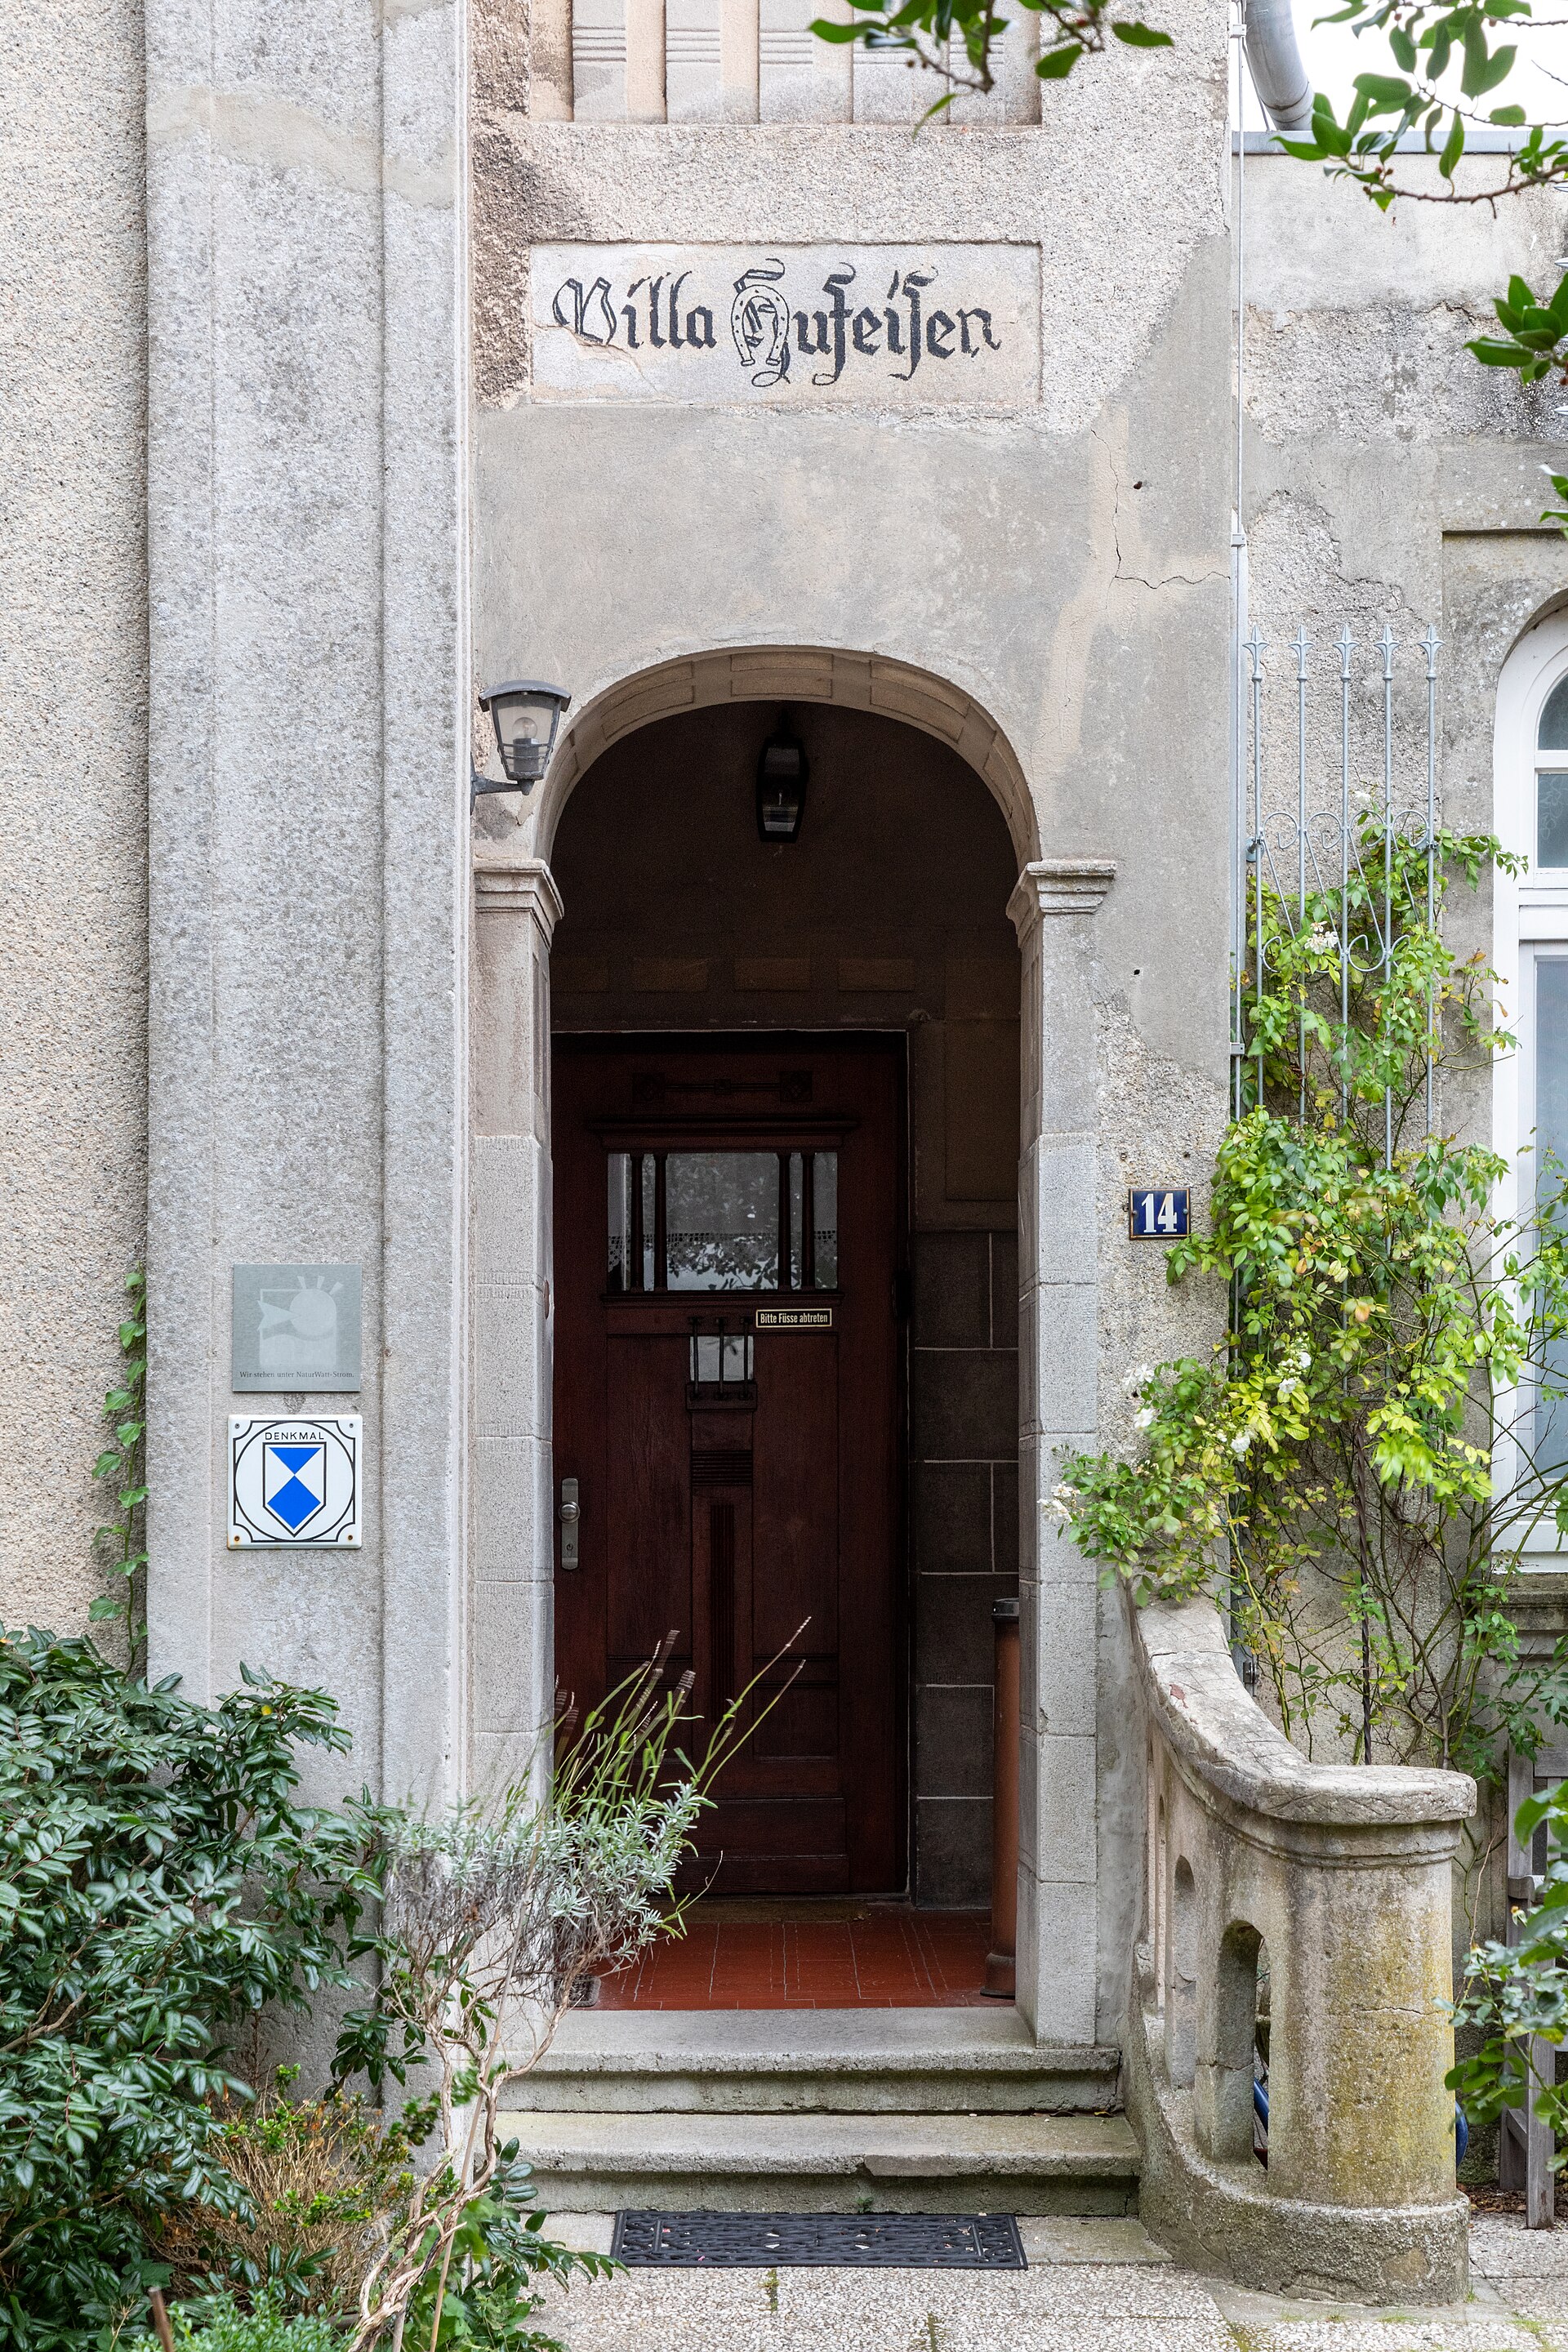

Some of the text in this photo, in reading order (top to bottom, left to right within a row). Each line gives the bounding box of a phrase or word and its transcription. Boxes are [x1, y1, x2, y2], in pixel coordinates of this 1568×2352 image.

[551, 270, 717, 350] Villa
[1141, 1192, 1178, 1233] 14
[760, 1312, 828, 1324] Bitte Füsse abtreten
[265, 1432, 325, 1441] DENKMAL
